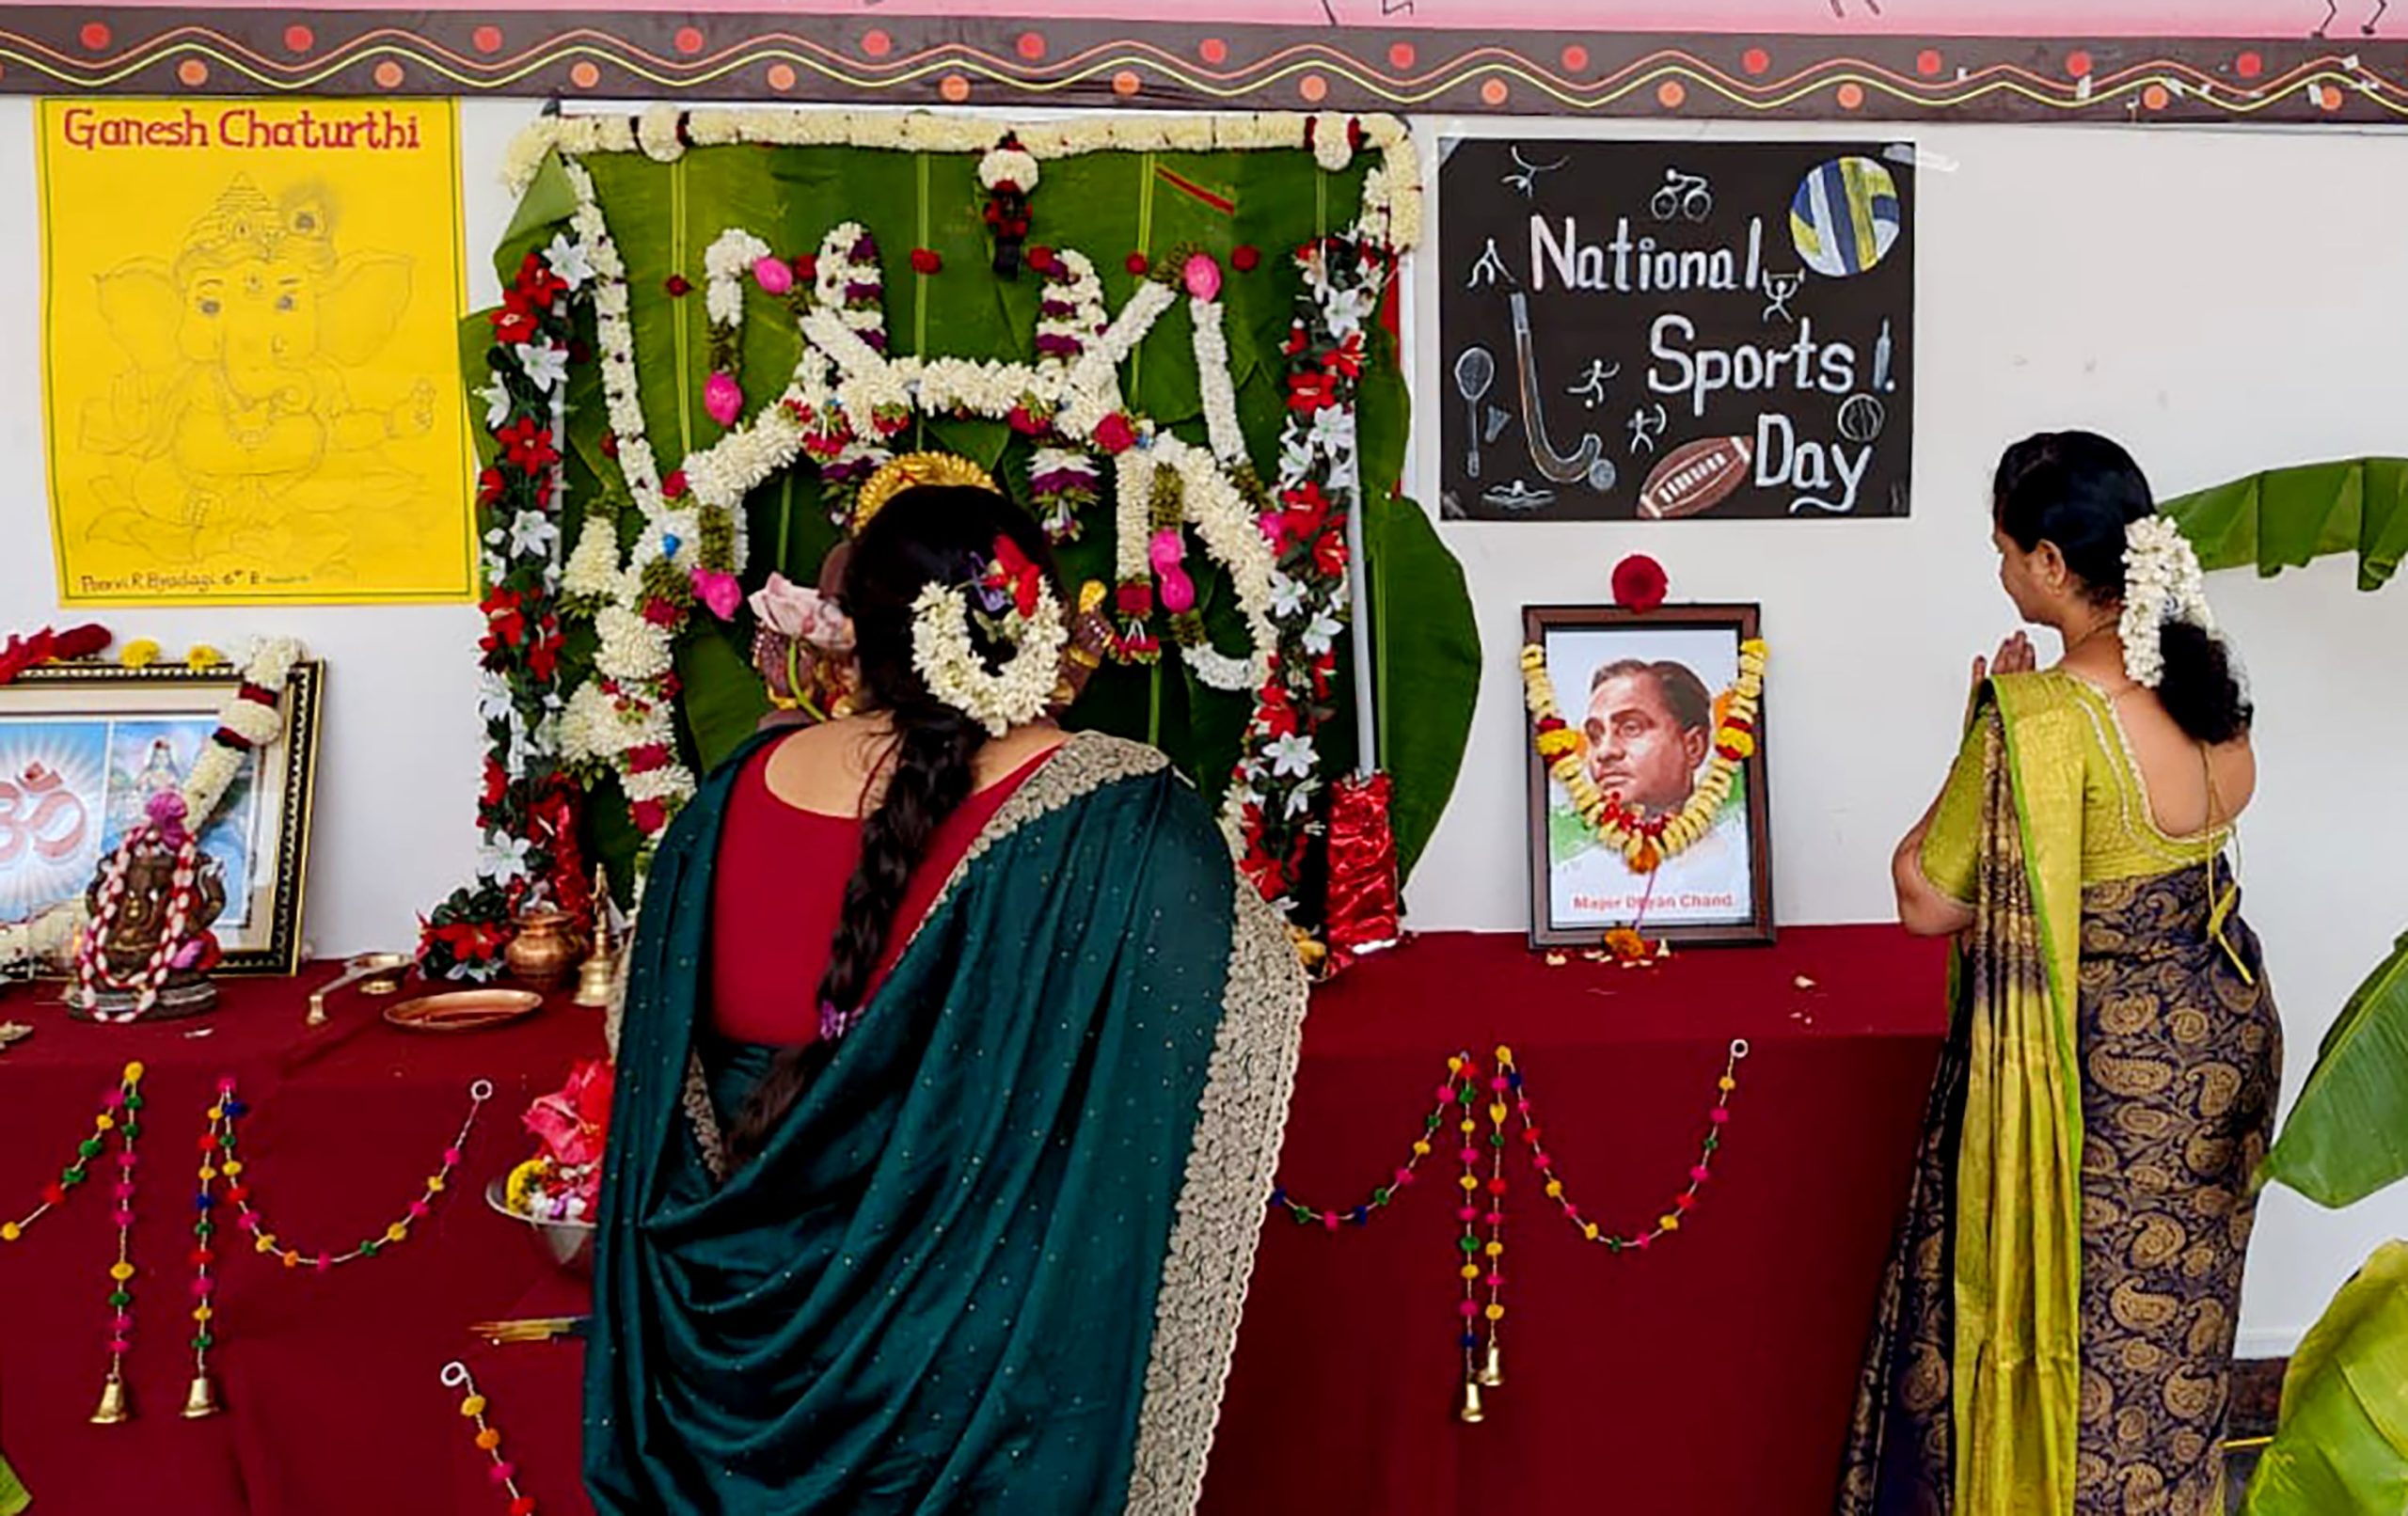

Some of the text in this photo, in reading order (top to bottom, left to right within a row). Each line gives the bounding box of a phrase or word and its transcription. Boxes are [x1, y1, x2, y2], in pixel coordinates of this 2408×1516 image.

[65, 108, 420, 150] Ganesh Chaturthi
[1530, 214, 1762, 292] National
[1755, 413, 1873, 513] Day
[1680, 894, 1733, 908] Chand
